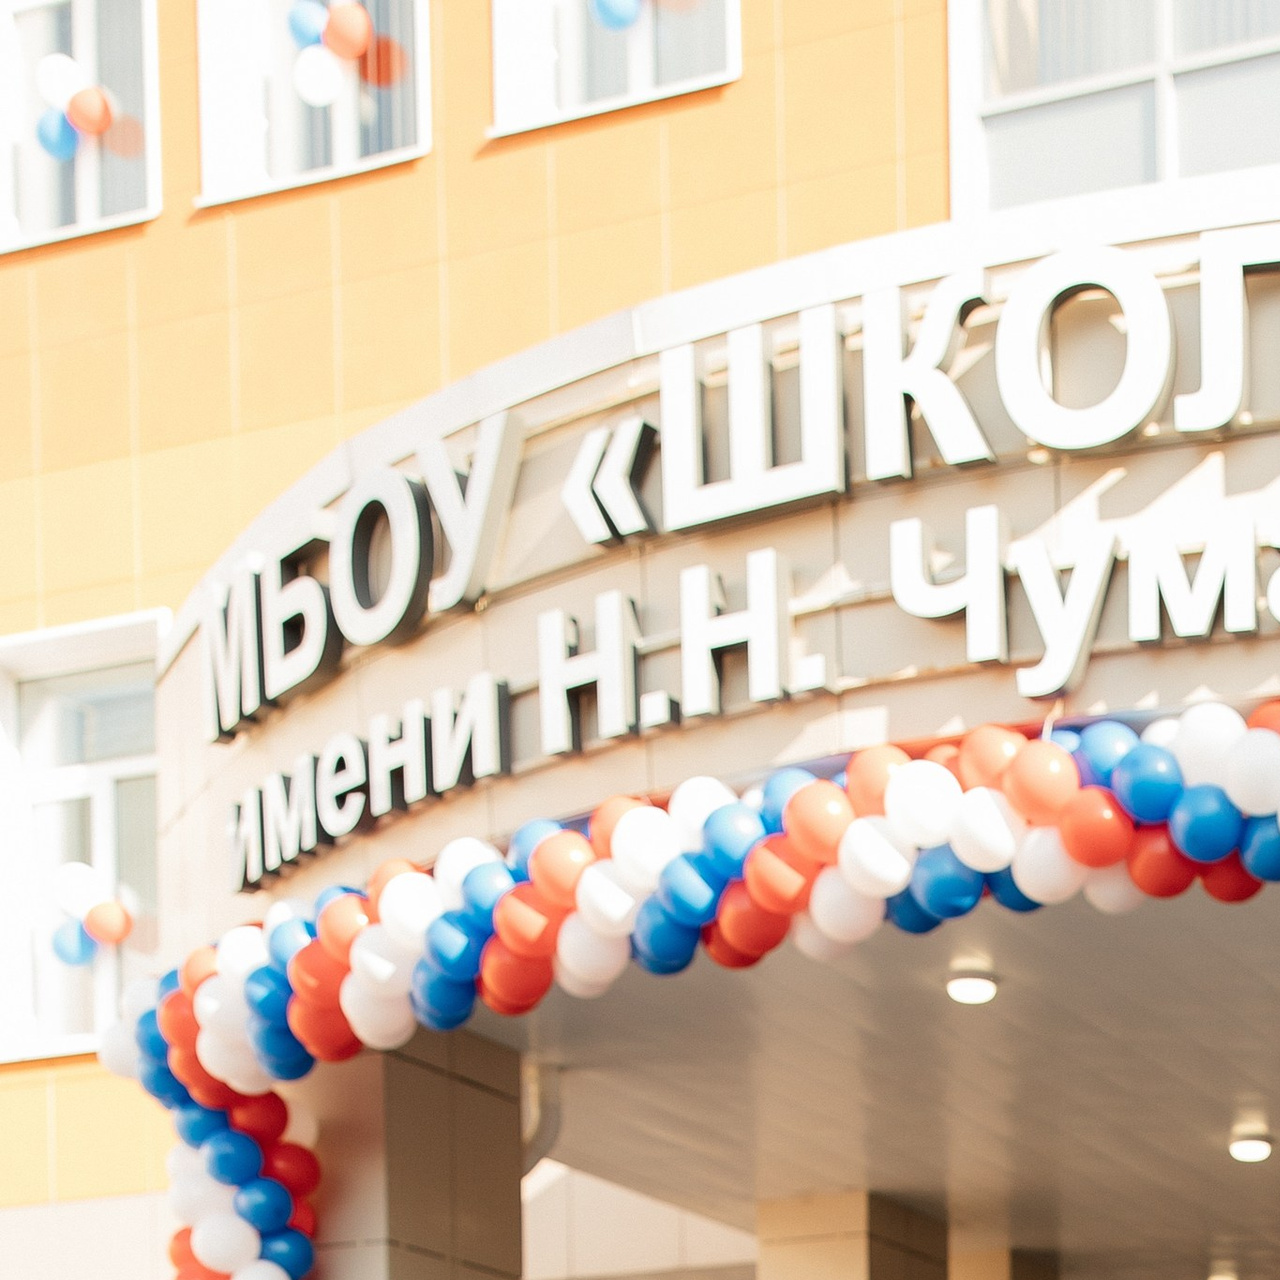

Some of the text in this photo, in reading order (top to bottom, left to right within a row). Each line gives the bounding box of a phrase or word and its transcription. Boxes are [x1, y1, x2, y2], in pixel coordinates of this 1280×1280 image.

[201, 408, 522, 745] МБОУ
[227, 671, 498, 893] имени
[538, 547, 827, 754] Н.Н.
